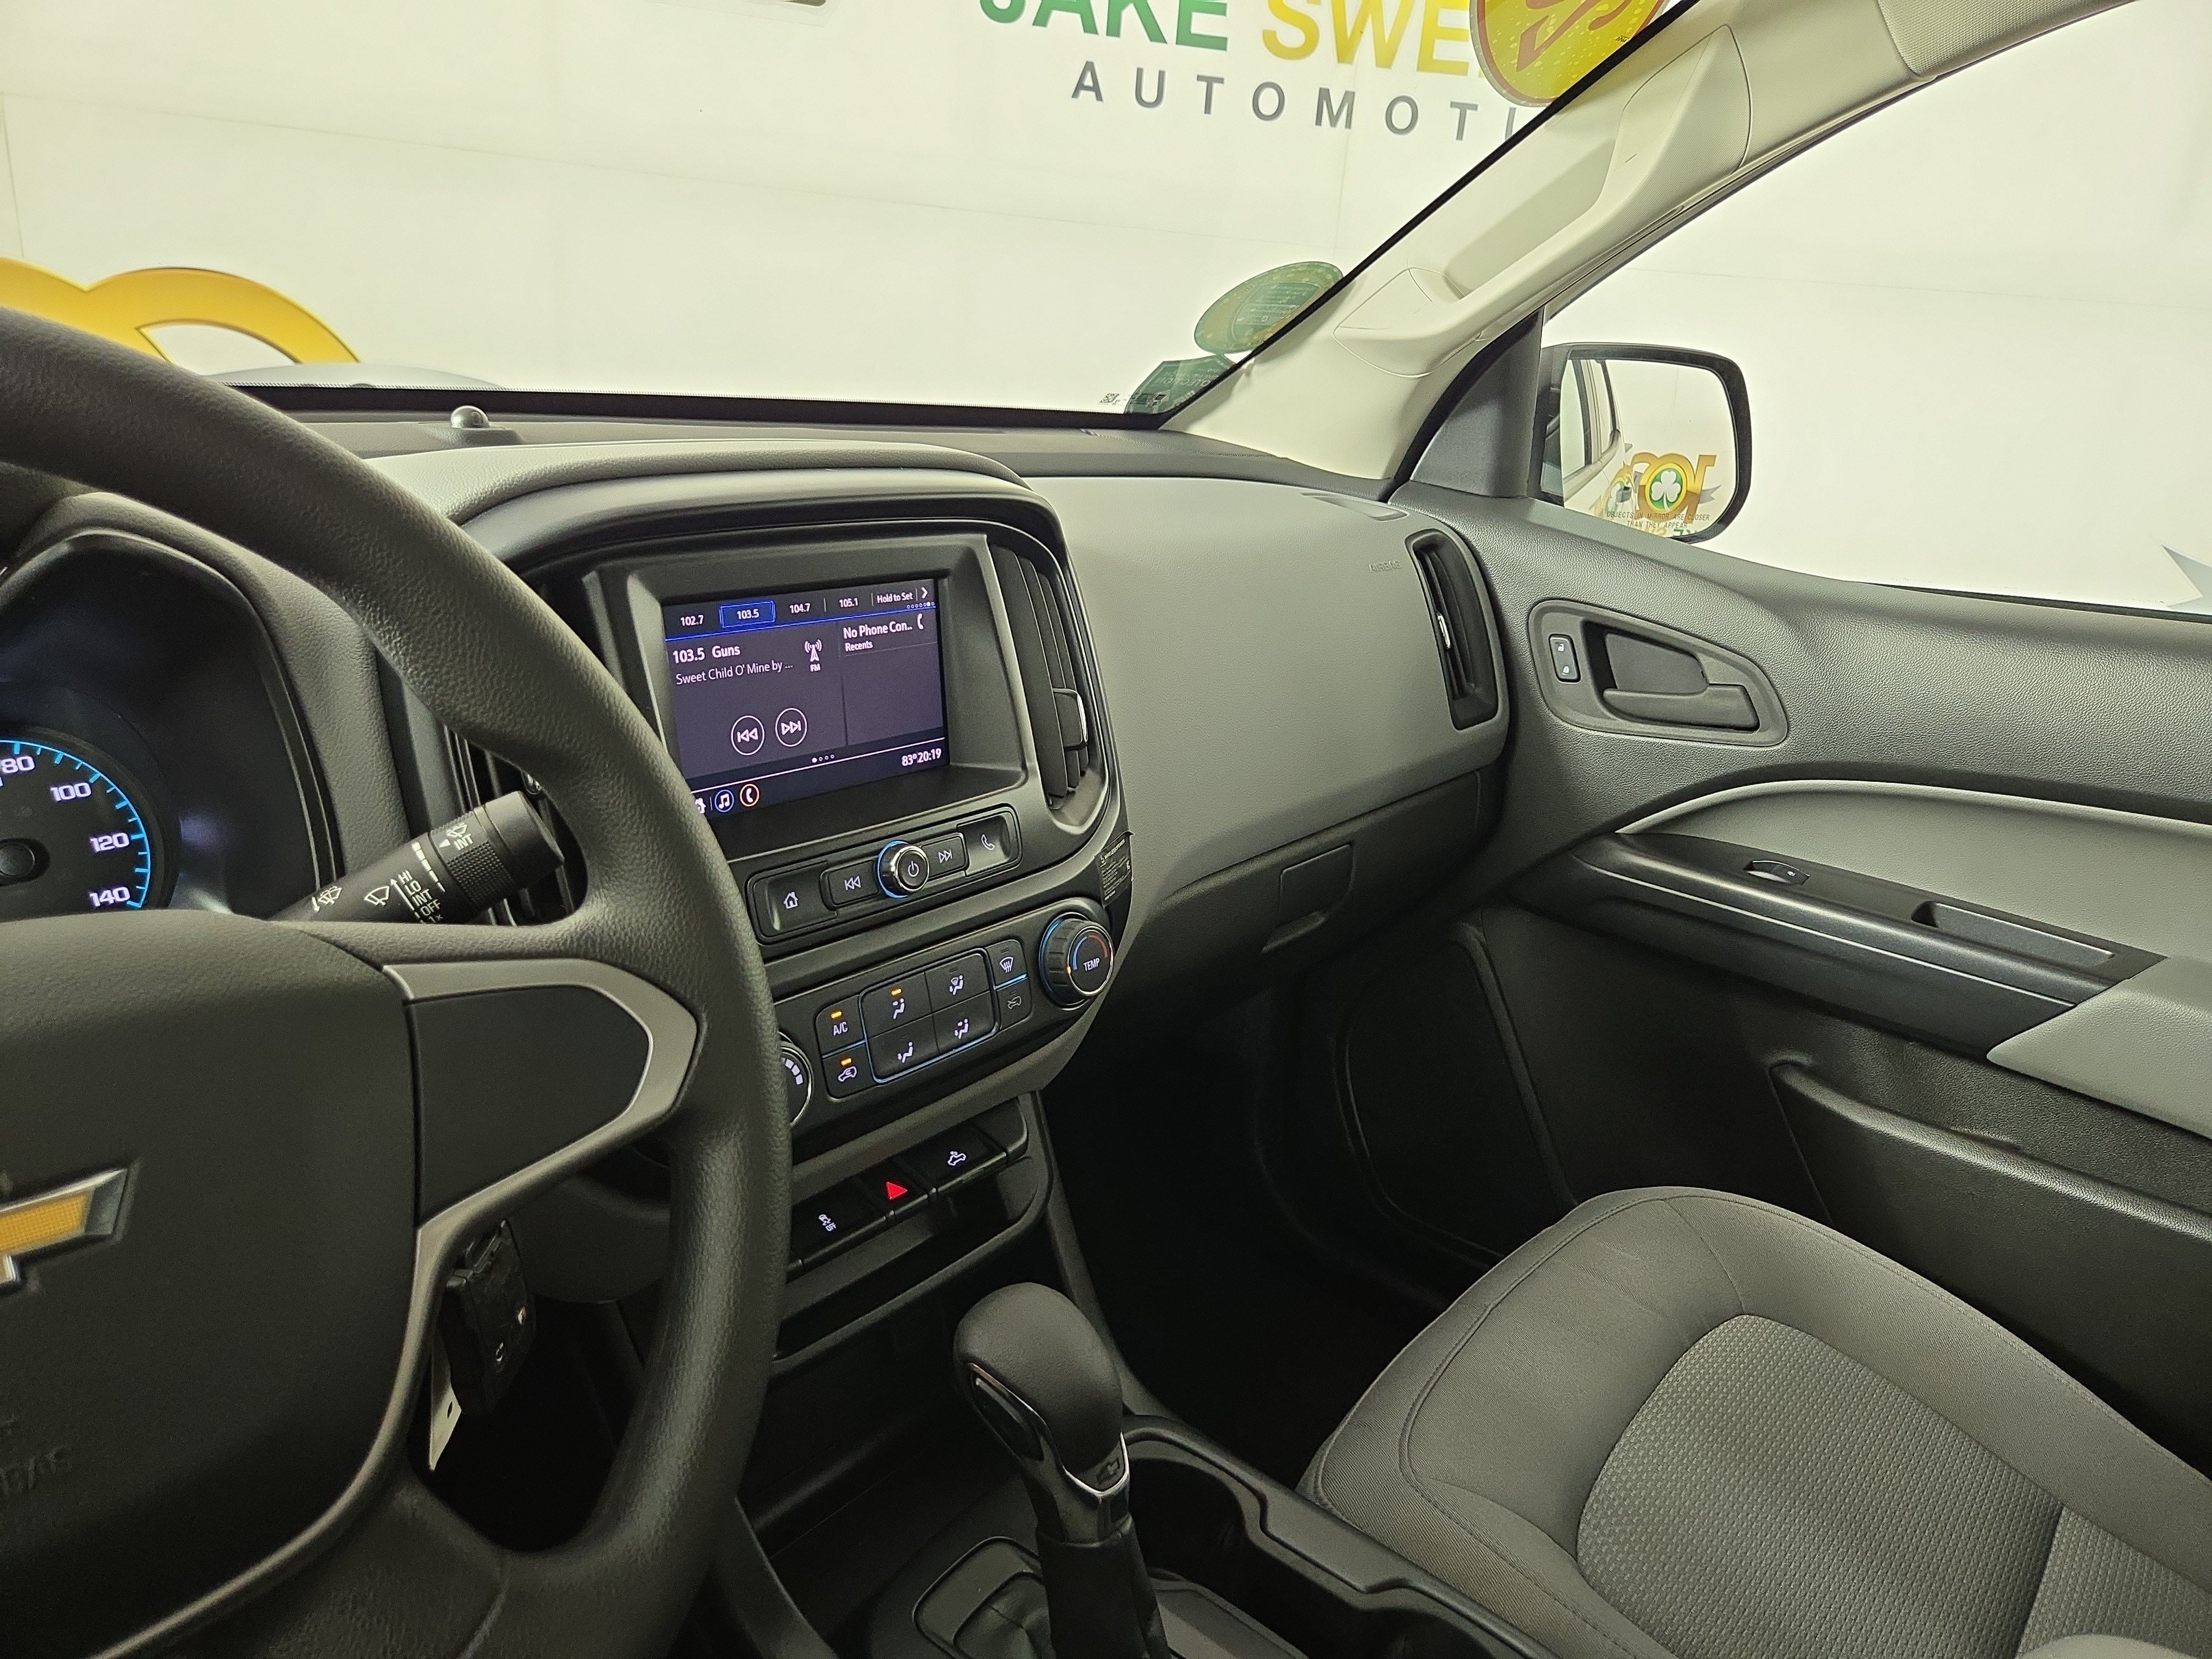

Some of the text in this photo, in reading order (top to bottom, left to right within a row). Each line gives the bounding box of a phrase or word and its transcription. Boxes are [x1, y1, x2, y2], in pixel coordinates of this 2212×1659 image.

[1262, 0, 1484, 78] SWE
[1606, 511, 1634, 519] OBJECTS
[1647, 512, 1669, 520] MIRROR
[1687, 513, 1710, 522] CLOSER
[1627, 520, 1642, 528] THAN
[1663, 521, 1688, 529] APPEAR
[680, 592, 913, 629] 102.7 103.5 104.7 105.1 Hold to Set
[843, 627, 858, 639] No
[859, 624, 889, 637] Phone
[845, 640, 873, 652] Recents
[672, 645, 741, 664] 103.5 Guns
[676, 671, 706, 685] Sweet
[708, 665, 734, 680] Child
[735, 664, 745, 677] O'
[747, 662, 770, 675] Mine
[771, 659, 783, 673] by
[809, 664, 821, 672] FM
[917, 748, 942, 763] 20:19
[1, 756, 35, 774] 80
[50, 782, 92, 801] 100
[89, 832, 130, 853] 120
[454, 833, 473, 851] INT
[398, 870, 413, 884] HI
[404, 880, 422, 896] LO
[89, 886, 131, 907] 140
[412, 889, 432, 906] INT
[420, 899, 441, 916] OFF
[1083, 957, 1100, 972] TEMP
[833, 1021, 848, 1036] A/C
[825, 1222, 837, 1232] OFF
